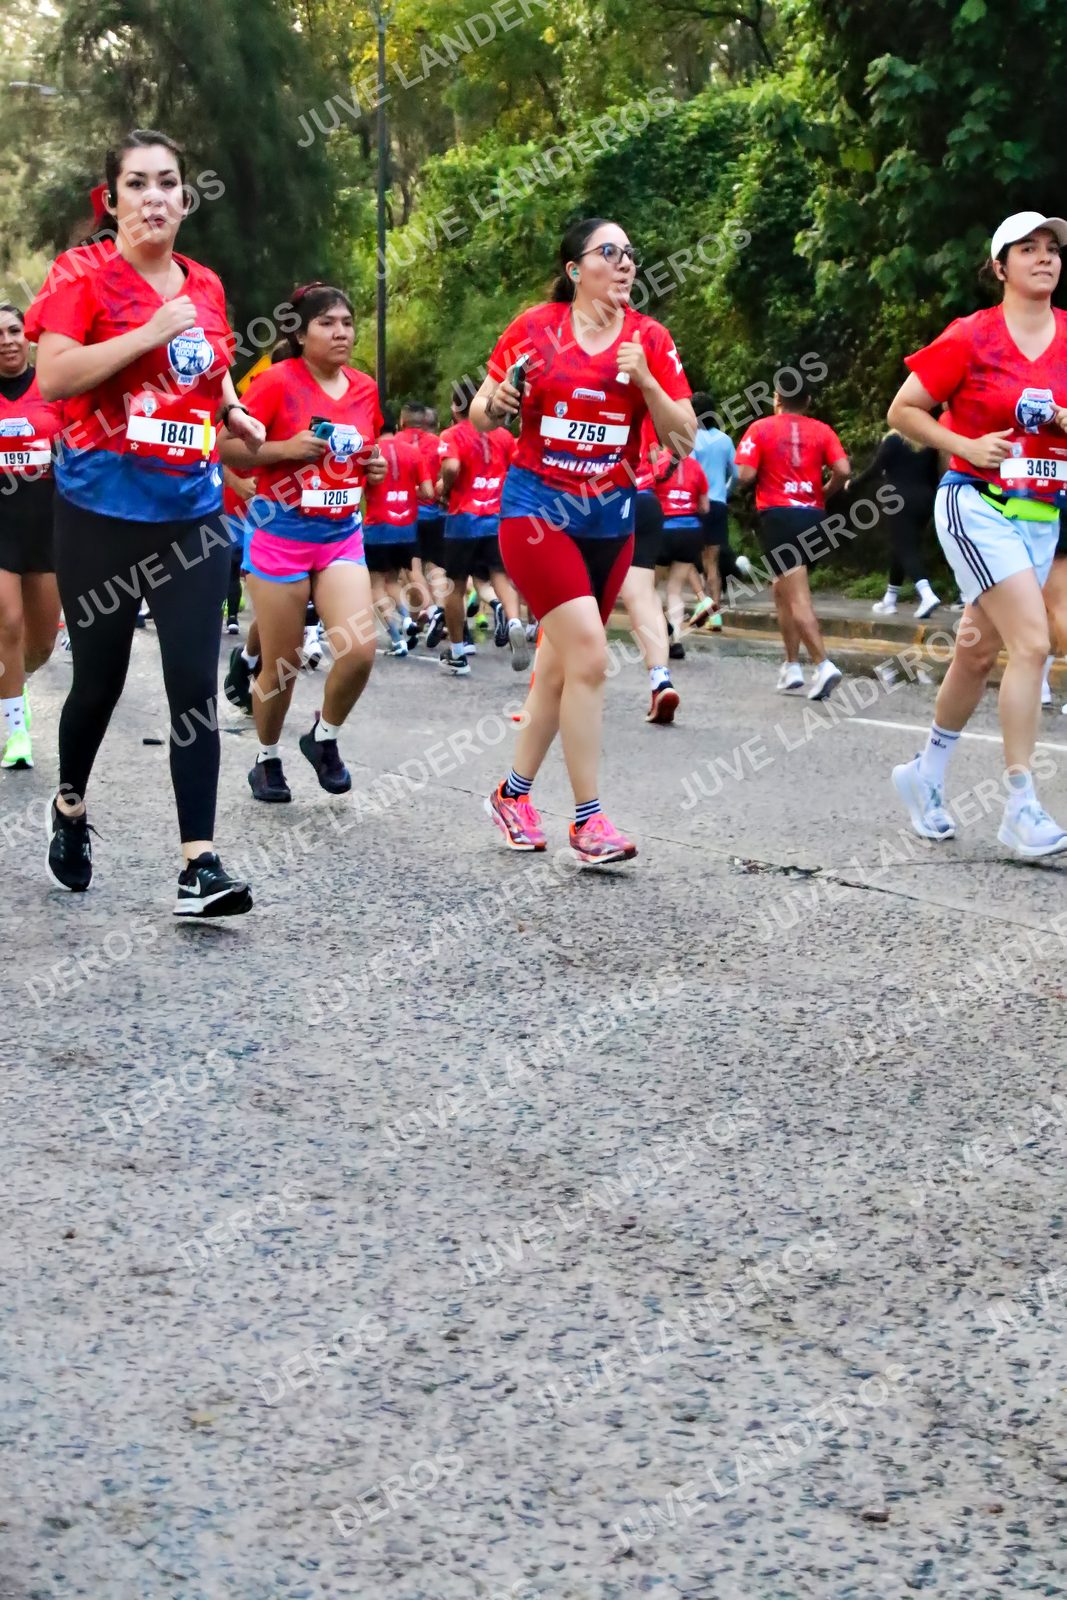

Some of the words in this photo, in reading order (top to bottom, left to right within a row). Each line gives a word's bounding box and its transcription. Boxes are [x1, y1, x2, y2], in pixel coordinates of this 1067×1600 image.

[161, 422, 194, 446] 1841
[567, 422, 606, 443] 2759
[4, 452, 30, 465] 1997
[1027, 460, 1057, 478] 3463
[323, 490, 348, 505] 1205
